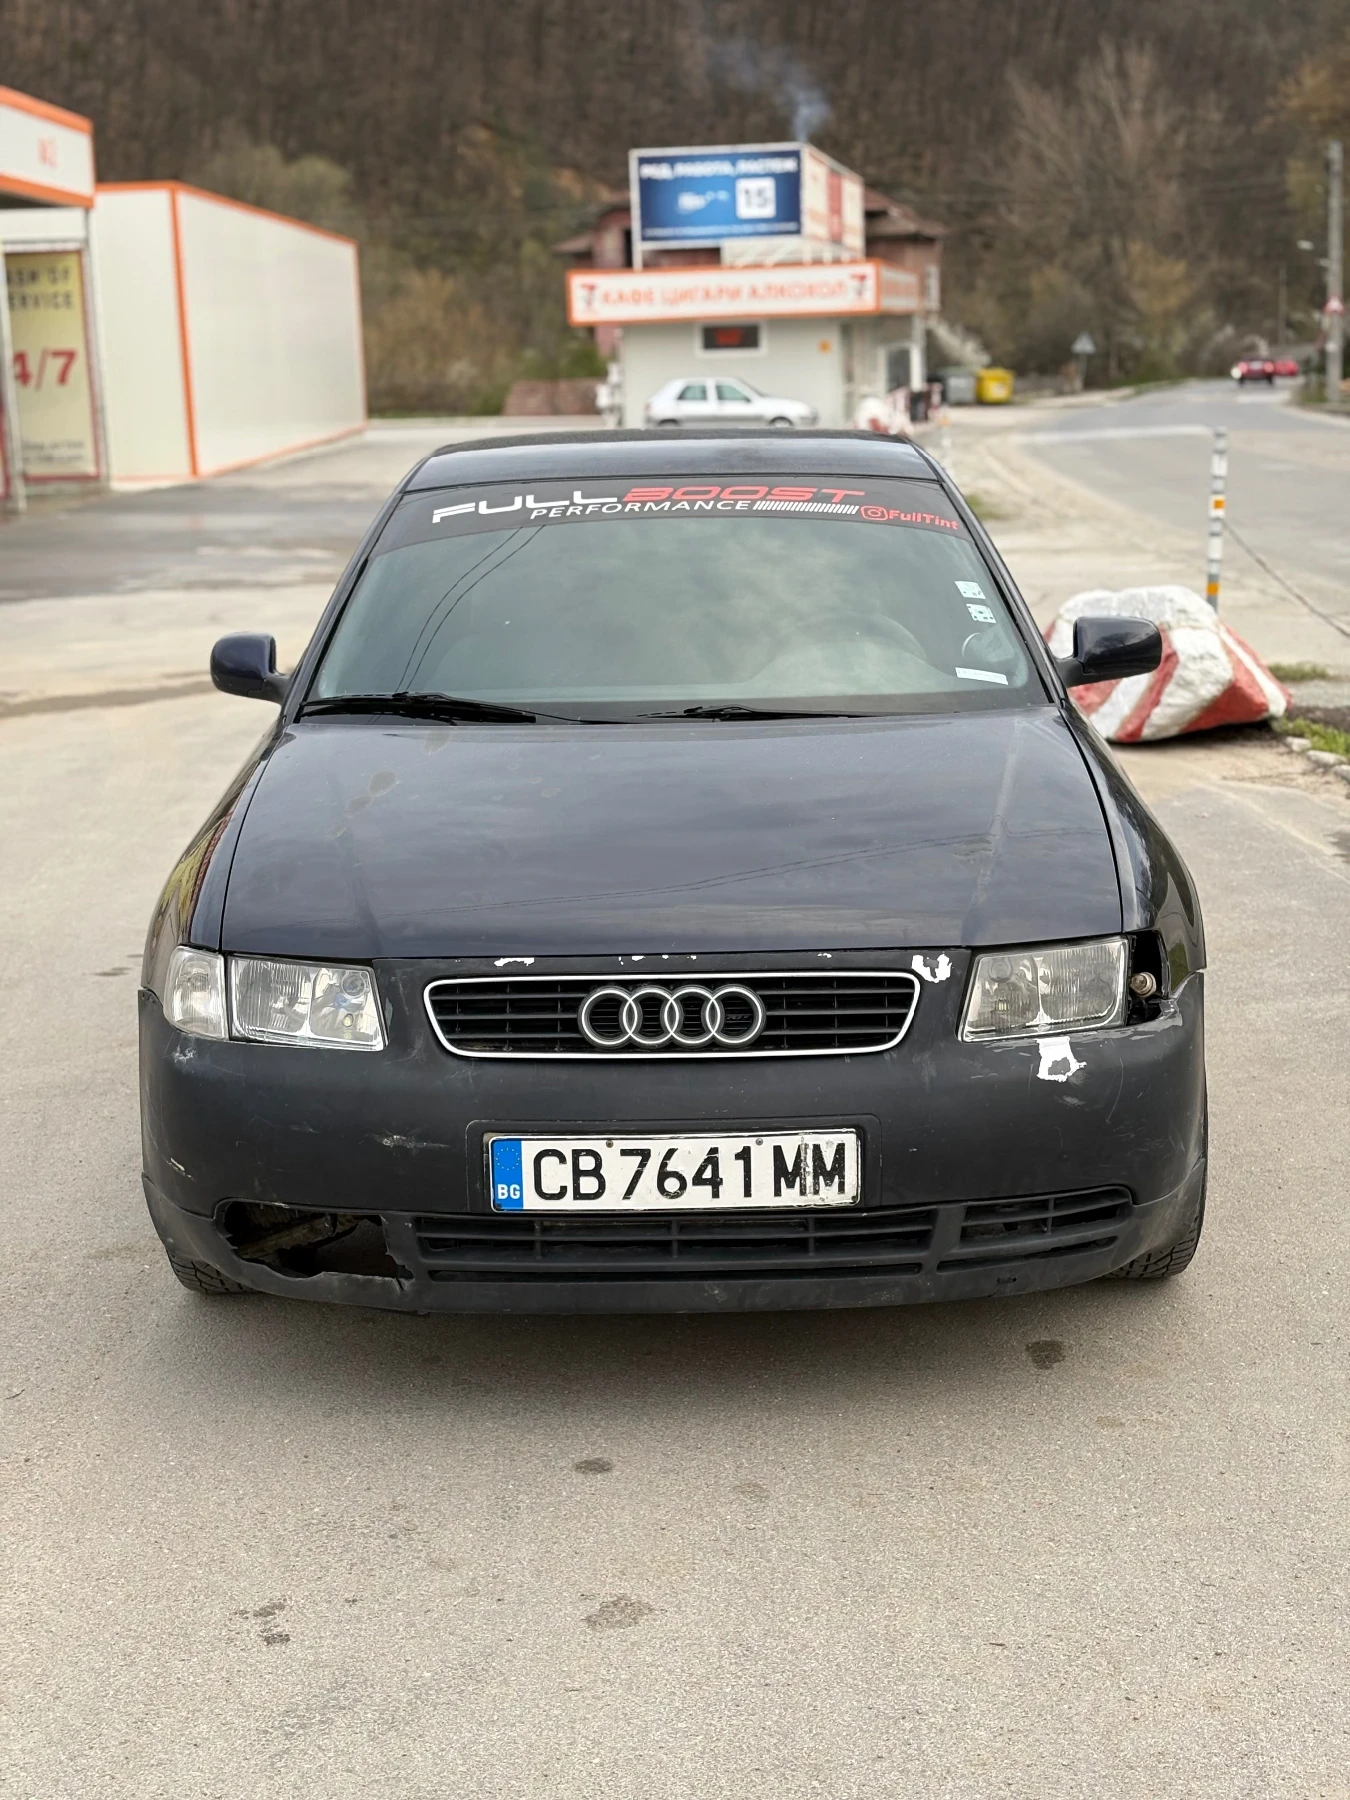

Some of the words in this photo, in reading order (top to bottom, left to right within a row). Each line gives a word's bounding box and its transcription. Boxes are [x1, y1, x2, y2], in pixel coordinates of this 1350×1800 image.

[744, 187, 768, 209] 15
[601, 287, 654, 306] КАФЕ
[662, 284, 741, 305] ЦИГАРИ
[432, 490, 617, 524] FULL
[623, 486, 865, 504] BOOST
[530, 500, 751, 520] PERFORMANCE
[888, 509, 959, 530] FullTint
[533, 1148, 607, 1201] CB
[619, 1144, 752, 1201] 7641
[771, 1142, 846, 1198] MM
[496, 1184, 521, 1200] BG
